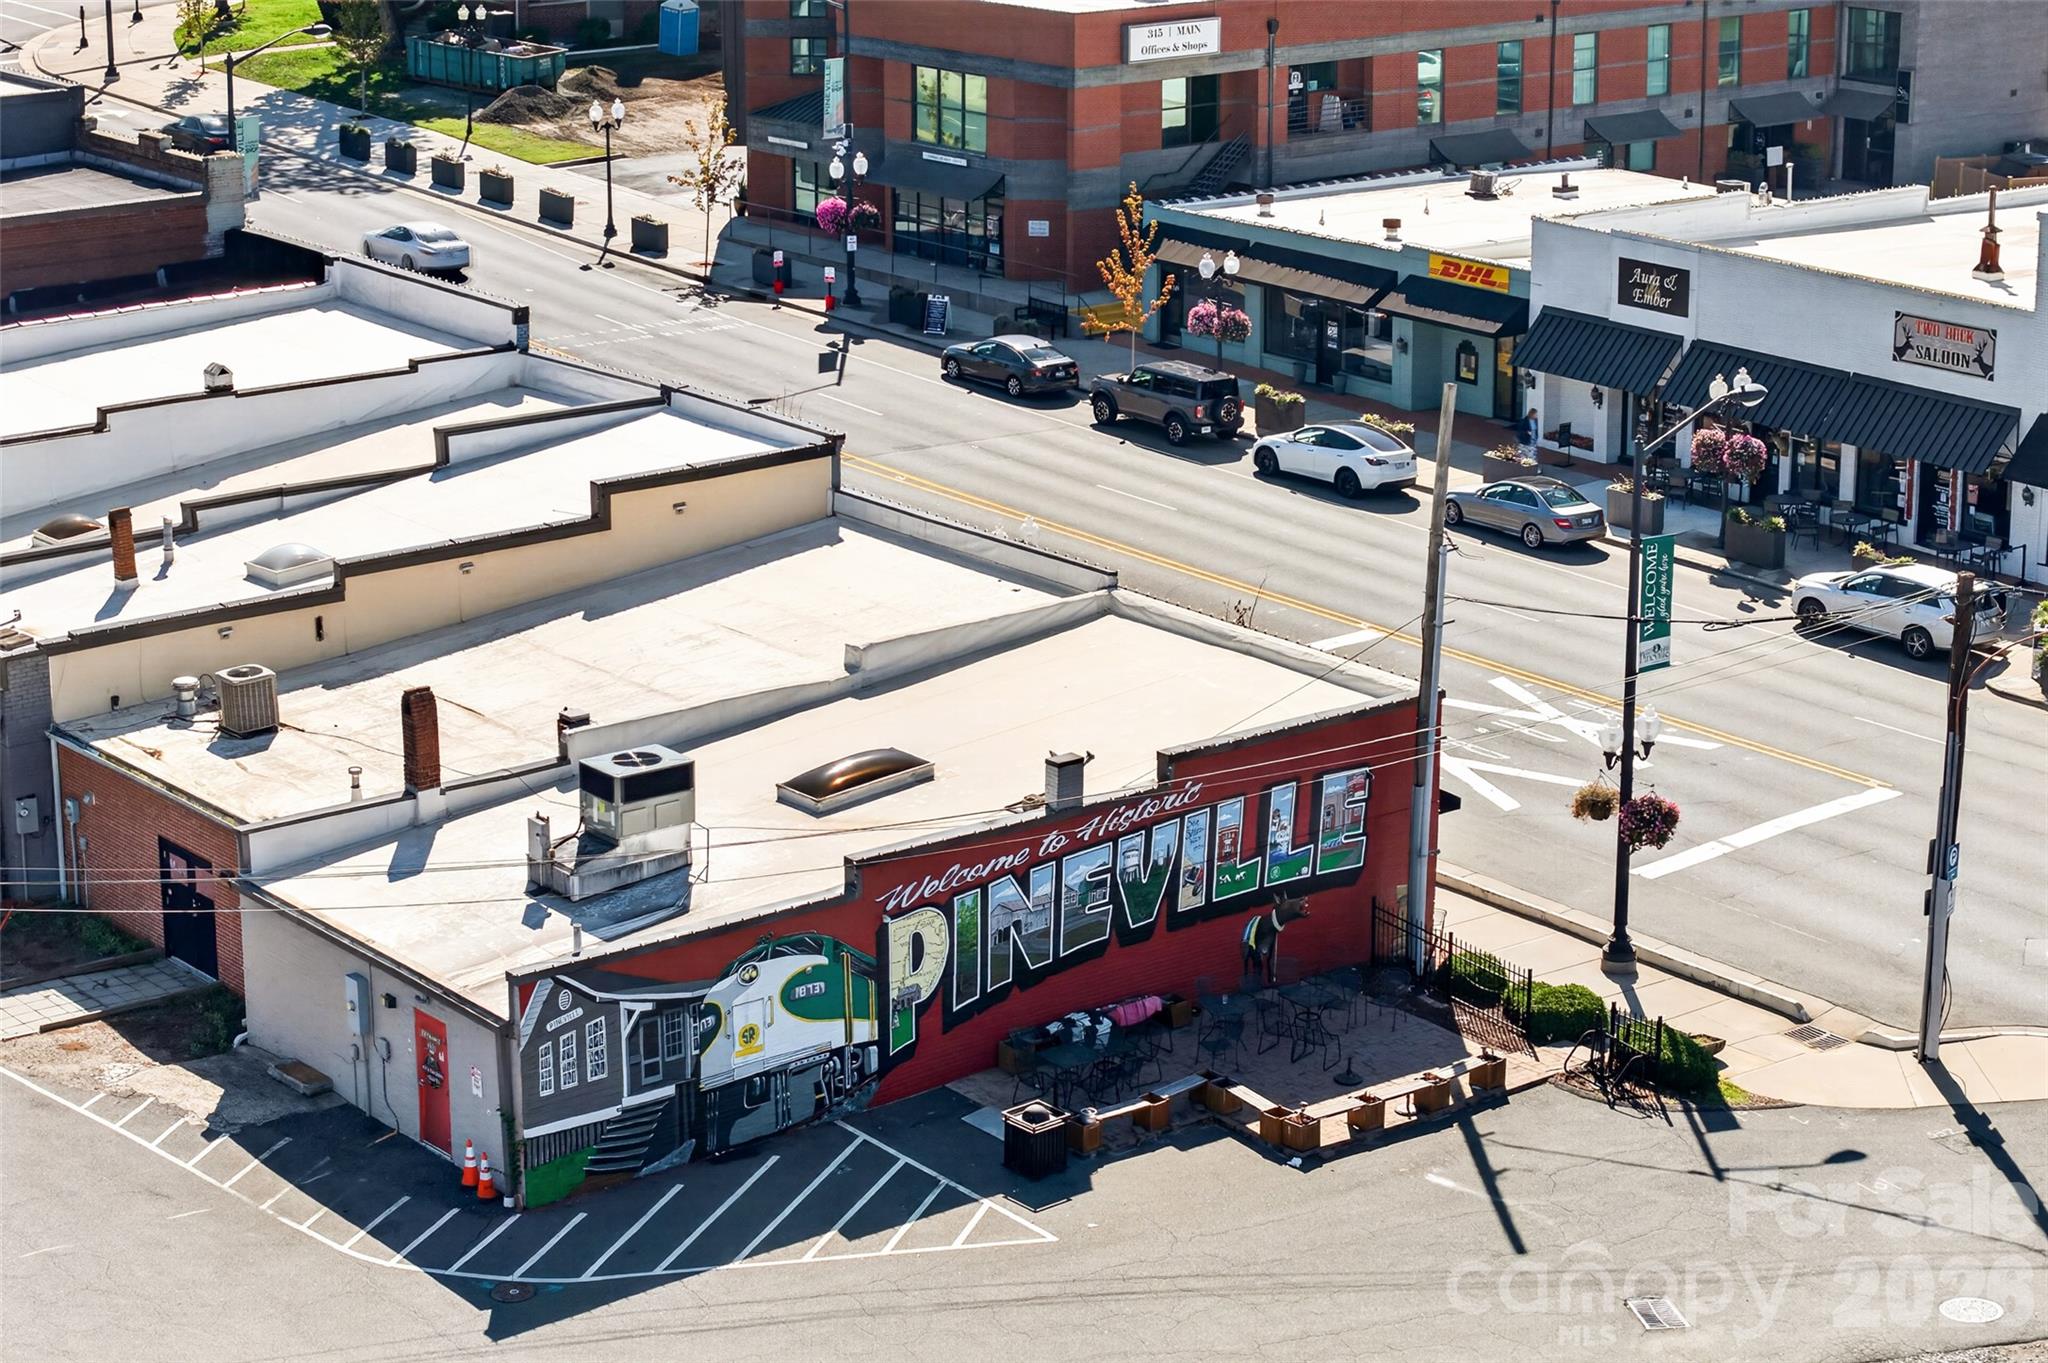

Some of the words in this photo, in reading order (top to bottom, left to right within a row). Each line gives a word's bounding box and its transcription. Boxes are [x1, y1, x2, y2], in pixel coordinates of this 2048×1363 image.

[1147, 28, 1164, 39] 315
[1176, 24, 1202, 36] MAIN
[1141, 44, 1171, 56] Offices
[1172, 43, 1180, 52] &
[1182, 41, 1208, 52] Shops
[1439, 259, 1501, 288] DHL
[1629, 267, 1661, 288] Aura
[1664, 273, 1679, 291] &
[1632, 288, 1672, 309] Ember
[1915, 319, 1941, 338] TWO
[1915, 344, 1971, 369] SALOON
[1658, 553, 1669, 572] here
[1643, 542, 1658, 637] WELCOME
[1655, 596, 1670, 618] glad
[875, 848, 1030, 911] Welcome
[1038, 830, 1069, 857] to
[1076, 781, 1204, 841] Historic
[888, 767, 1369, 1056] PINEVILLE
[794, 982, 821, 999] 1873
